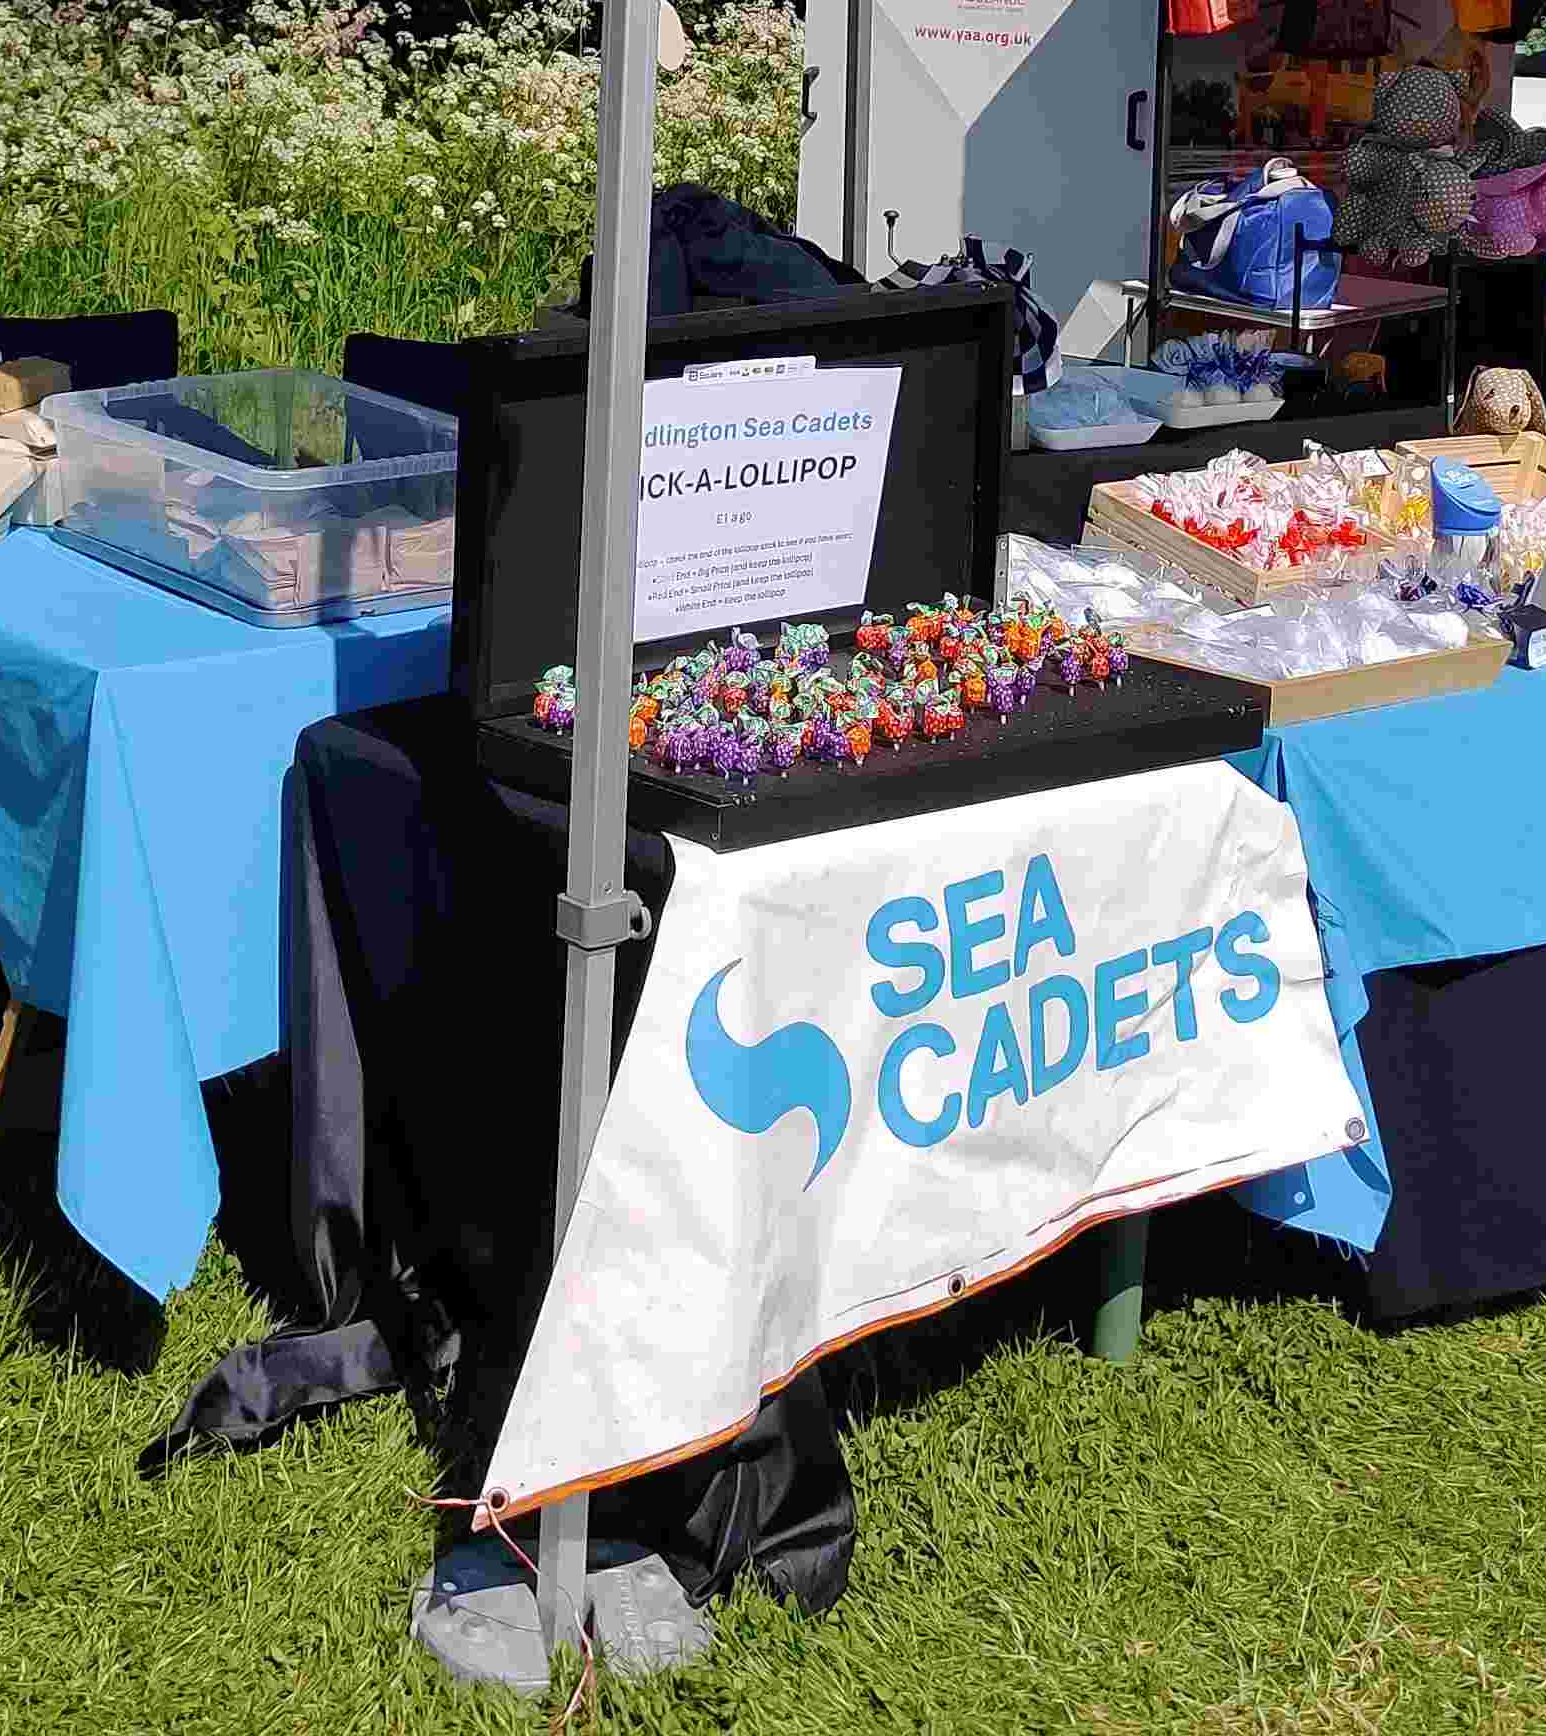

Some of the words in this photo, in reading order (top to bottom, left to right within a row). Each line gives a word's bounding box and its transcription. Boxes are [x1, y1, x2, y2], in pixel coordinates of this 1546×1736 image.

[914, 25, 1032, 47] www.yaa.org.uk
[645, 425, 737, 448] dlington
[743, 417, 786, 438] Sea
[792, 412, 872, 435] Cadets
[640, 454, 857, 501] ICK-A-LOLLIPOP
[866, 852, 1076, 1018] SEA
[877, 910, 1281, 1147] CADETS
